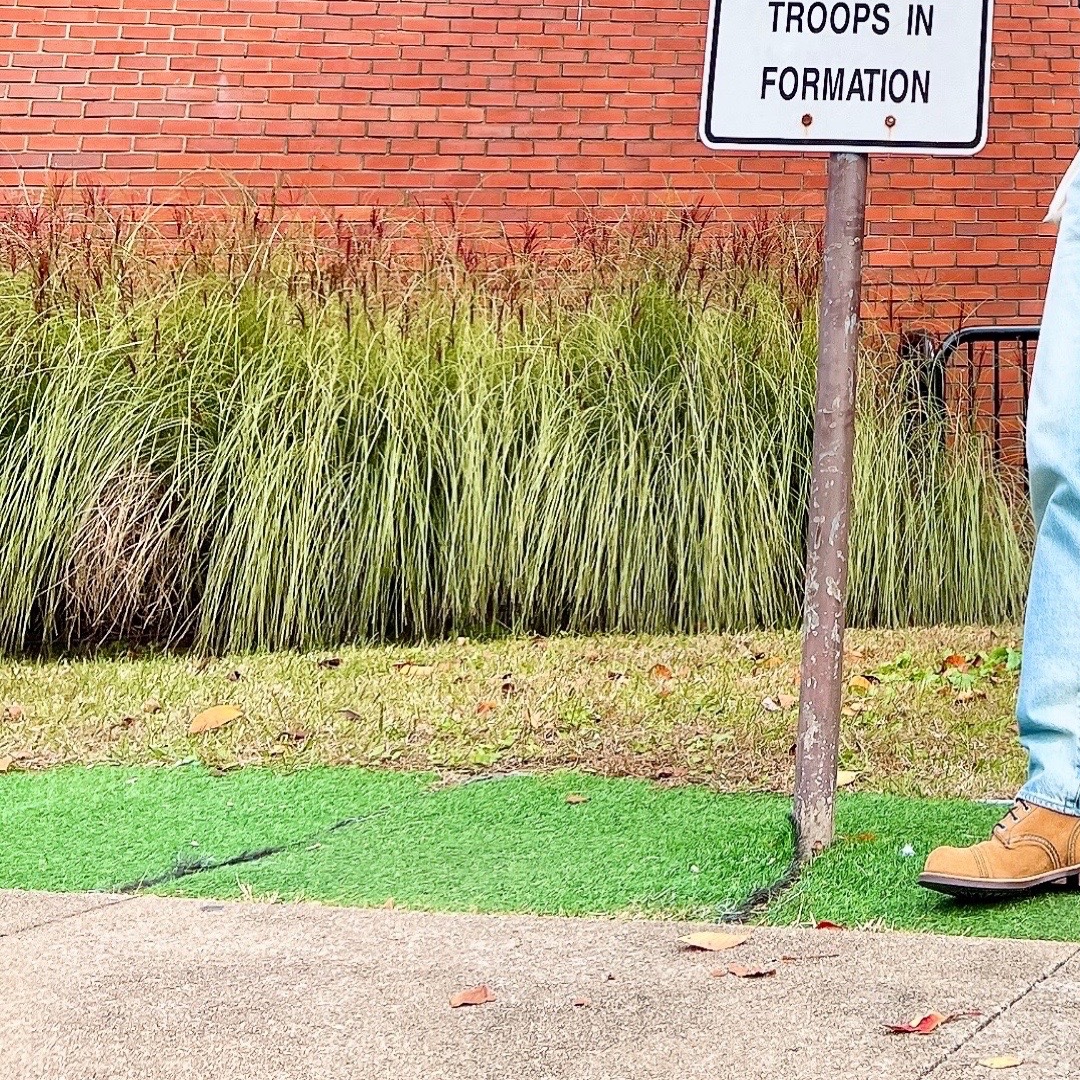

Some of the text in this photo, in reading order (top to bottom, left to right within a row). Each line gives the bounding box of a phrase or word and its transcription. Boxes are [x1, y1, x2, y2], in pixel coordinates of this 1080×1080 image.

[768, 1, 934, 36] TROOPS IN
[760, 66, 930, 104] FORMATION
